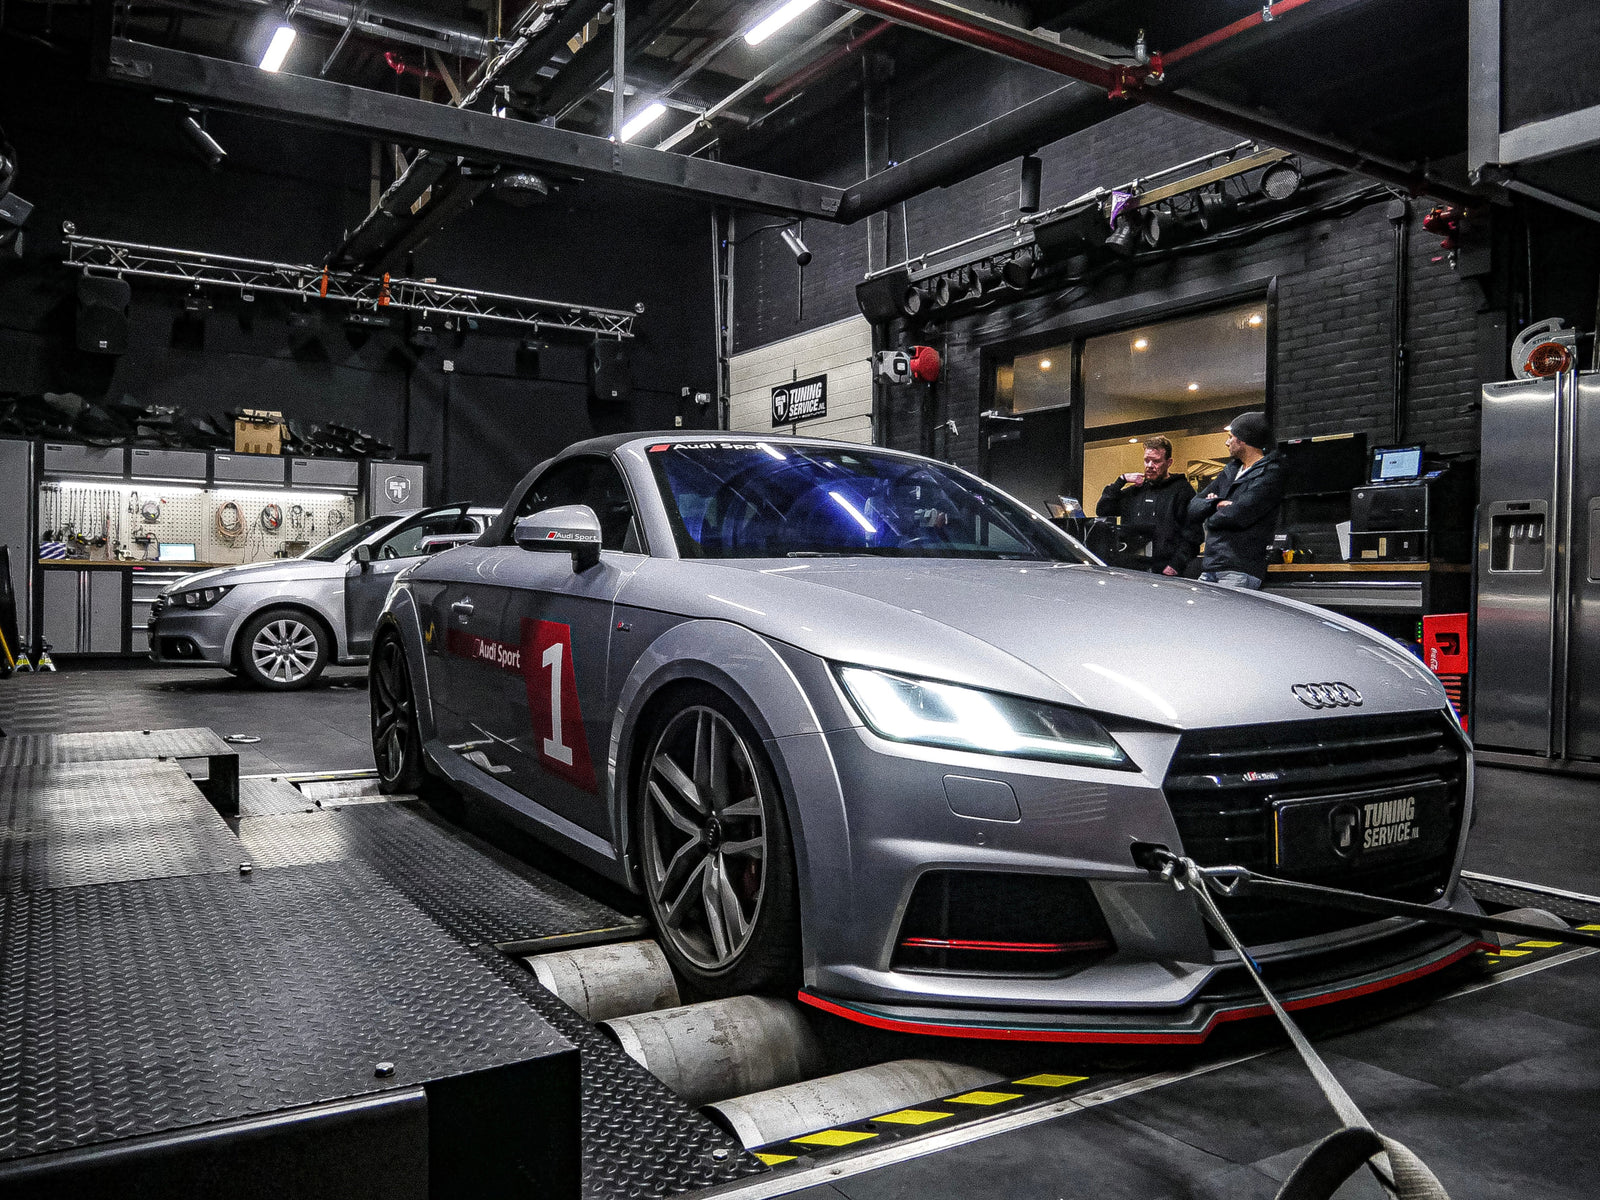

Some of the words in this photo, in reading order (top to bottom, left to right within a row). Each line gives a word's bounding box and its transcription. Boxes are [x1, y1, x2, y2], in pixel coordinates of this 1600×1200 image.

[789, 382, 823, 405] TUNING
[574, 533, 597, 541] Sport
[479, 640, 497, 660] Audi
[497, 644, 521, 669] Sport
[542, 642, 573, 766] 1
[1364, 797, 1415, 828] TUNING
